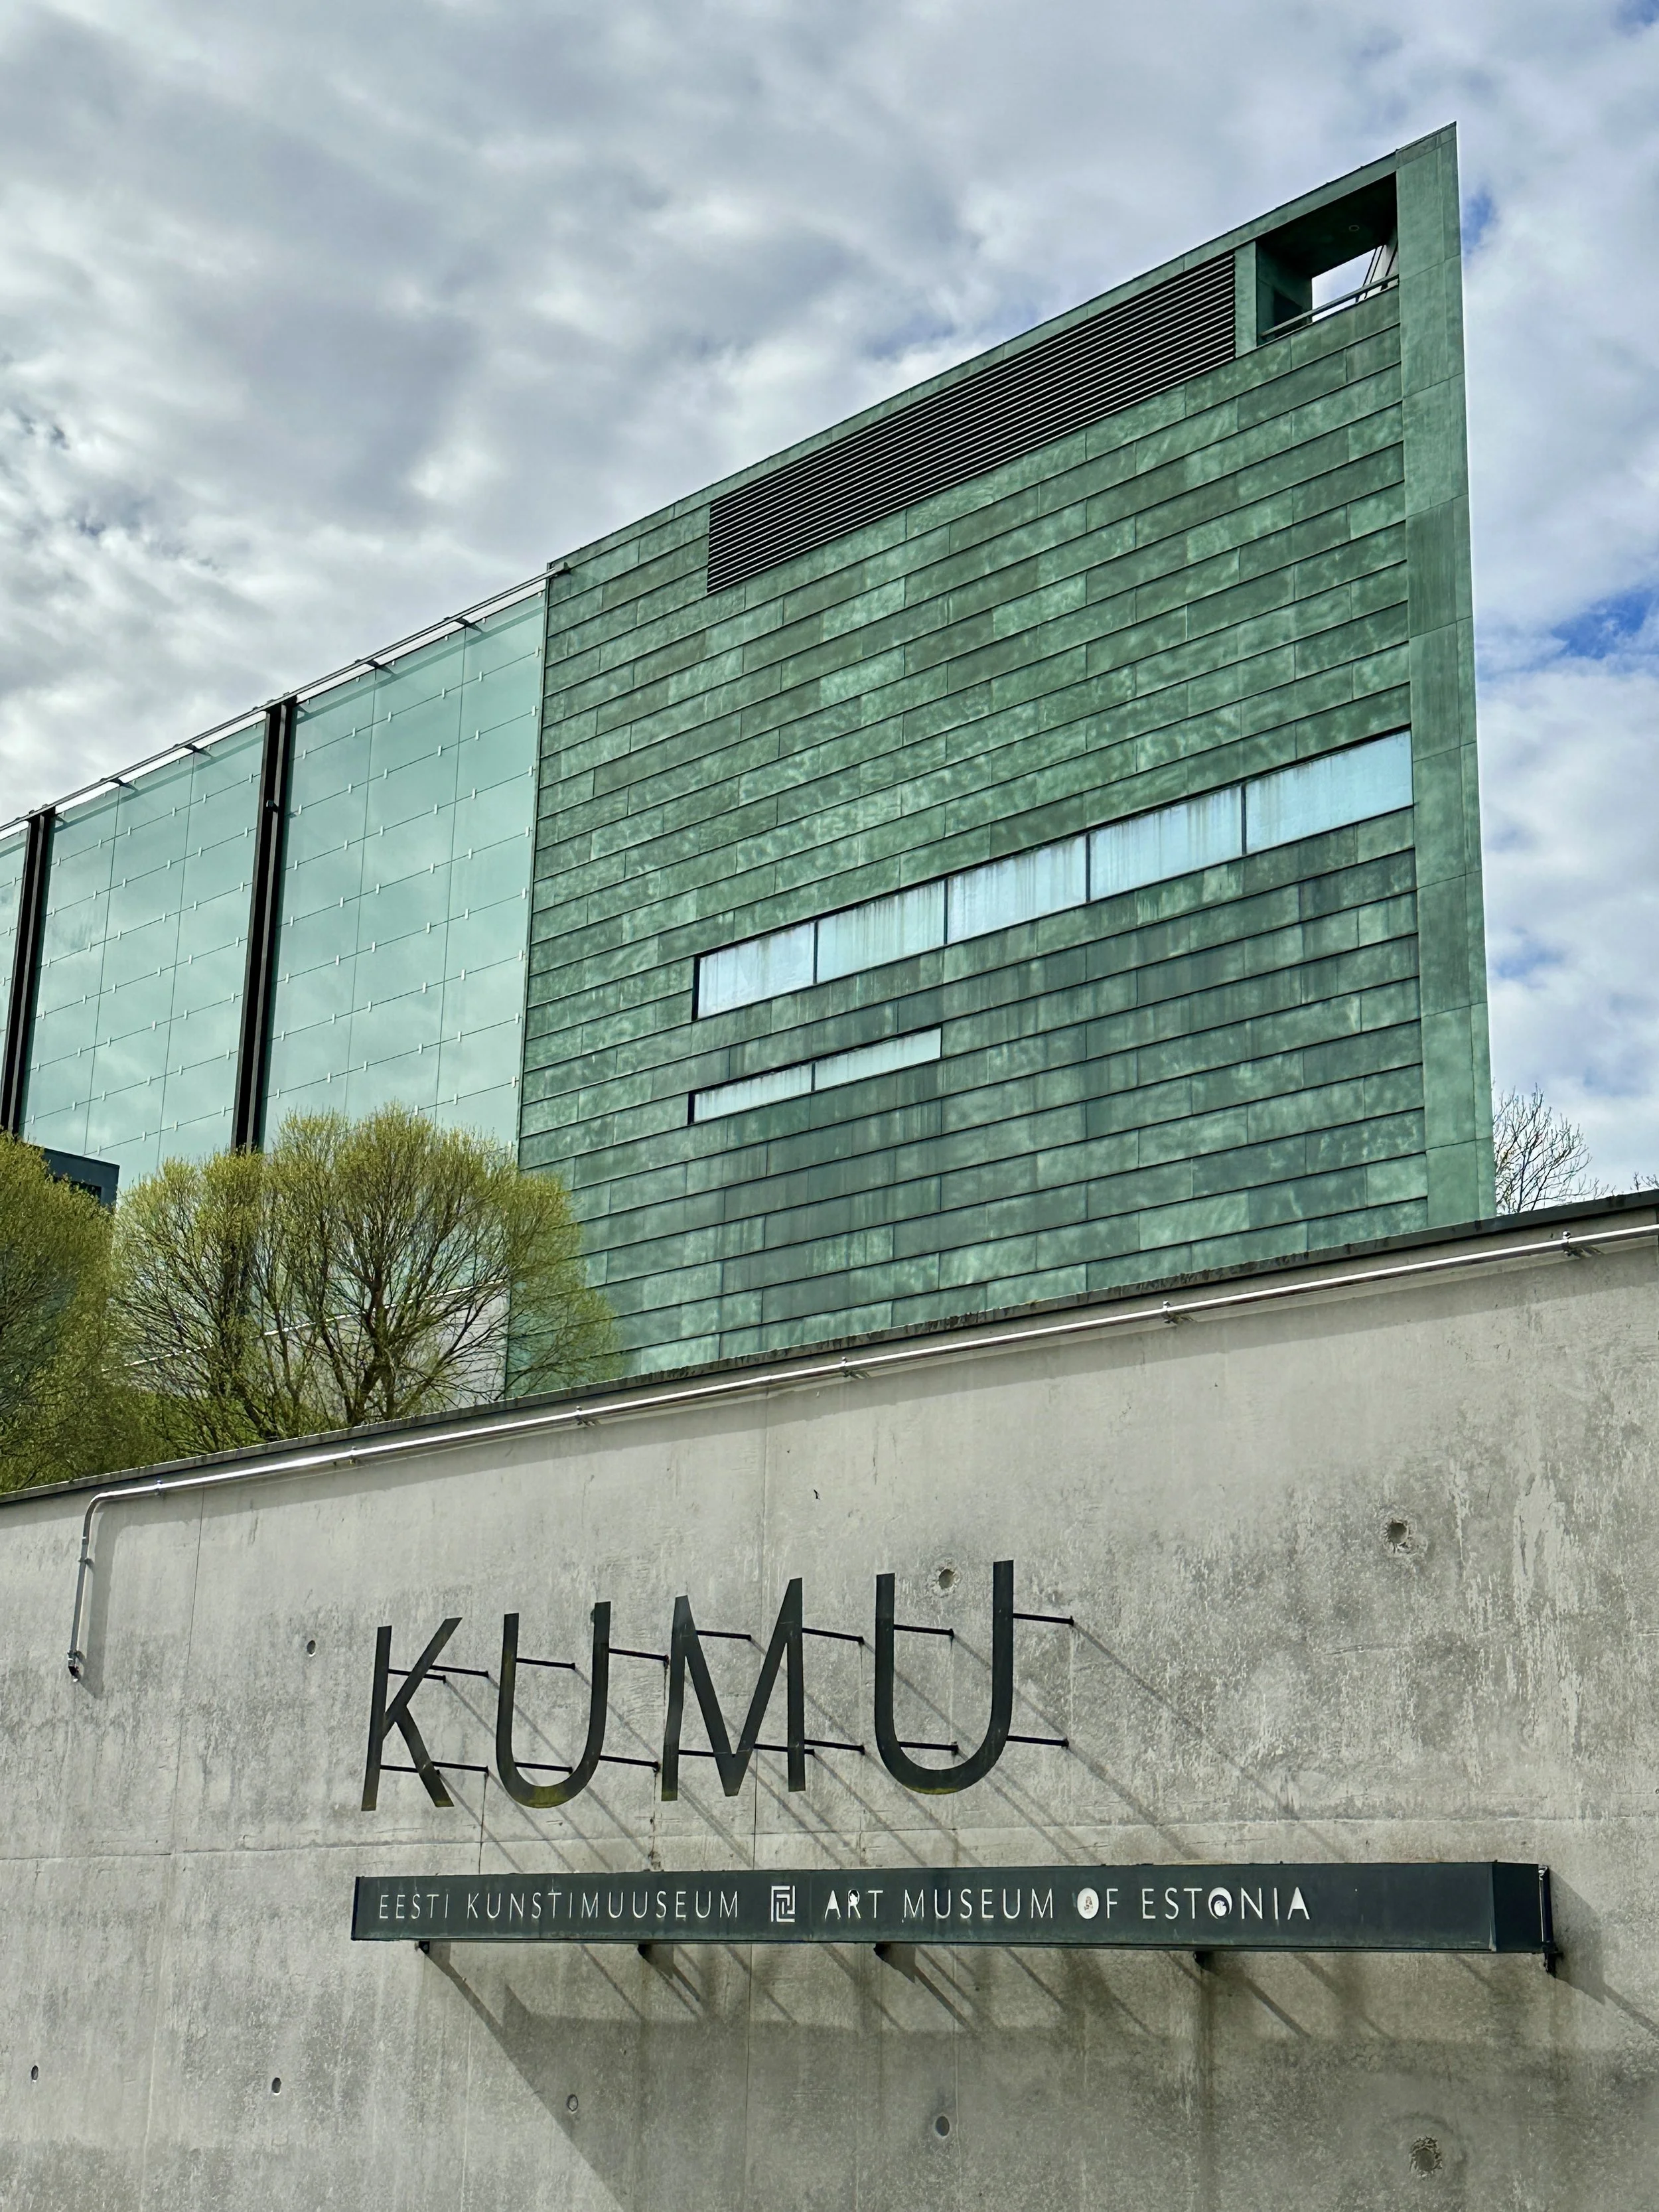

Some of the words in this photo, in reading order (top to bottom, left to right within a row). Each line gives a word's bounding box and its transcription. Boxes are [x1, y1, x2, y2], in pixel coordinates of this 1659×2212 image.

[361, 1560, 1014, 1812] KUMU
[378, 1893, 449, 1920] EESTI
[467, 1890, 739, 1920] KUNSTIMUUSEUM
[824, 1889, 884, 1920] ART
[902, 1888, 1054, 1920] MUSEUM
[1077, 1887, 1119, 1919] OF
[1141, 1886, 1311, 1920] ESTONIA
